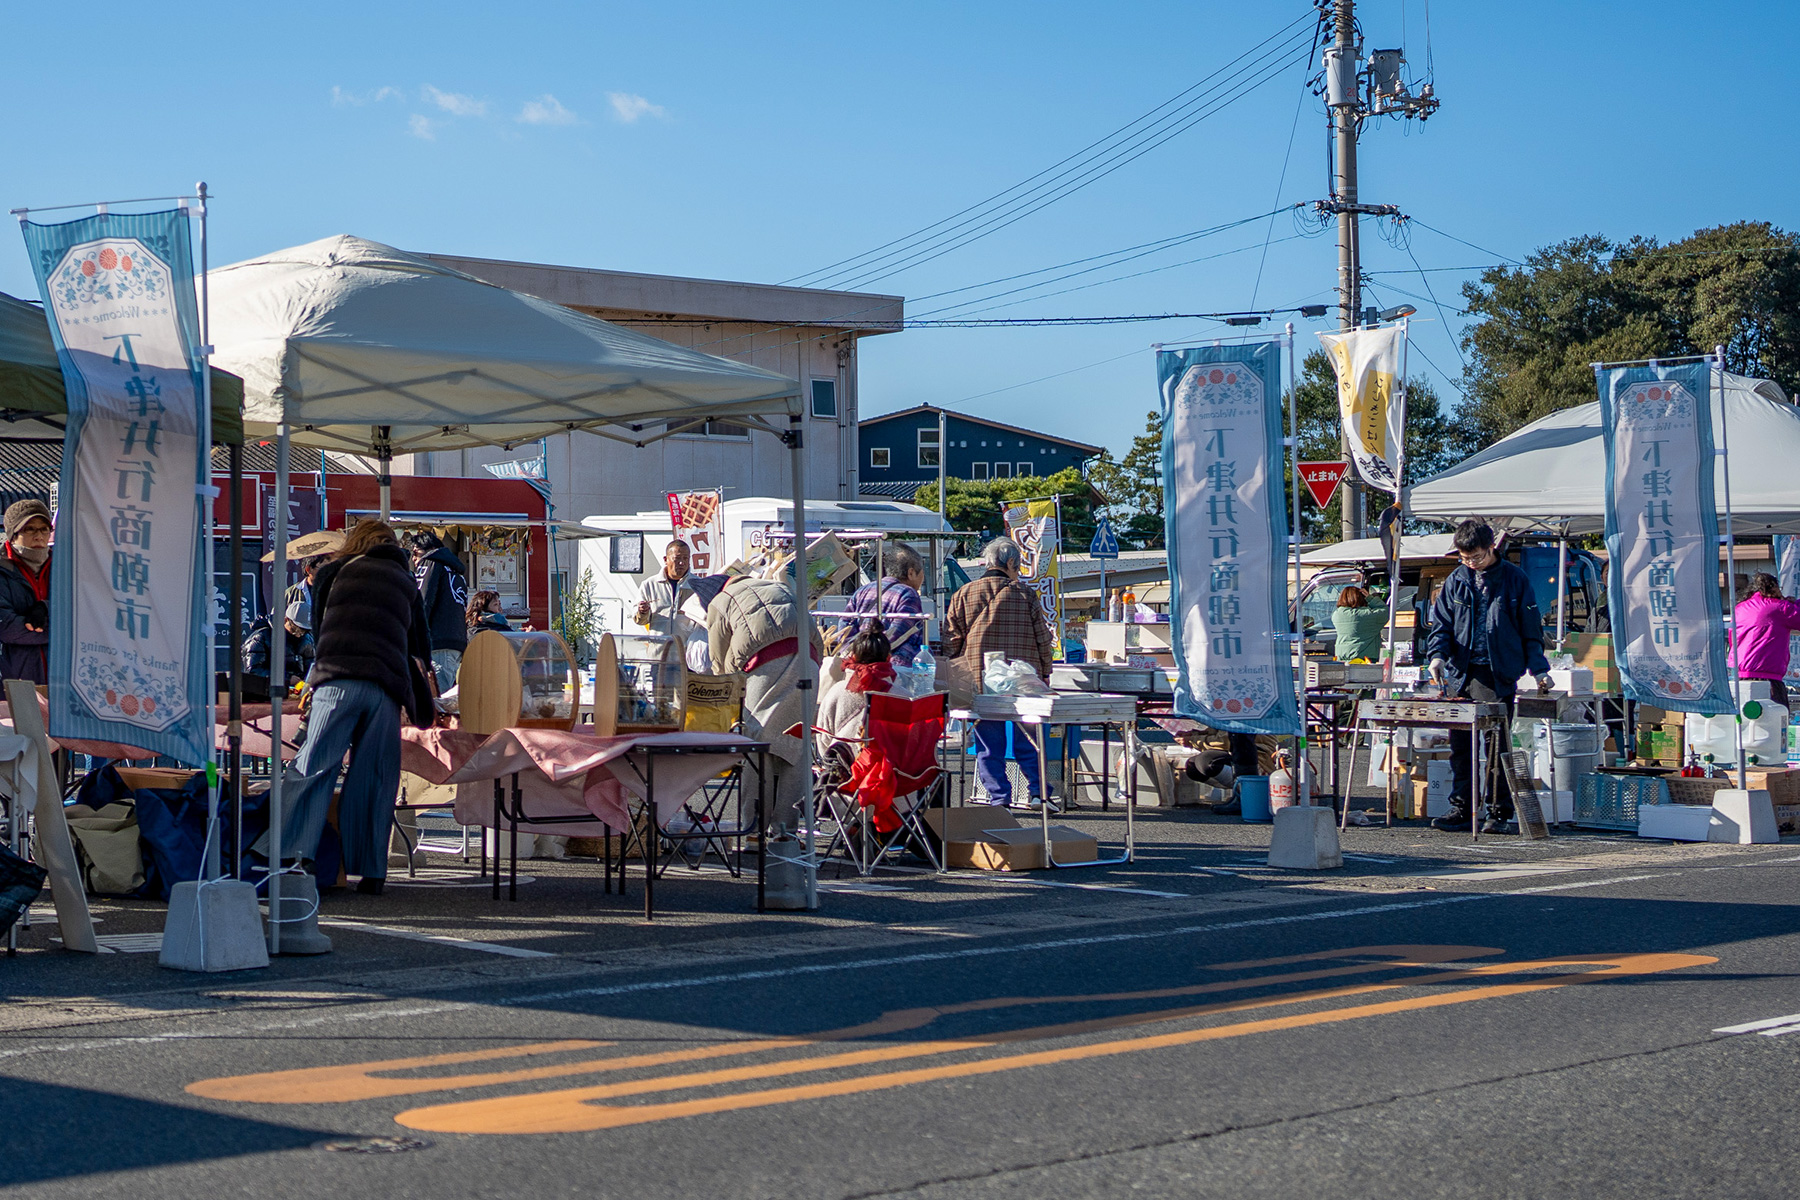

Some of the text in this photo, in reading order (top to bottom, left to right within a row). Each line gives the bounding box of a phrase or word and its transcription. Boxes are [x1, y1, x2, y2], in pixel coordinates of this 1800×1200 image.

[1307, 470, 1338, 482] 止まれ
[688, 683, 722, 698] Coleman
